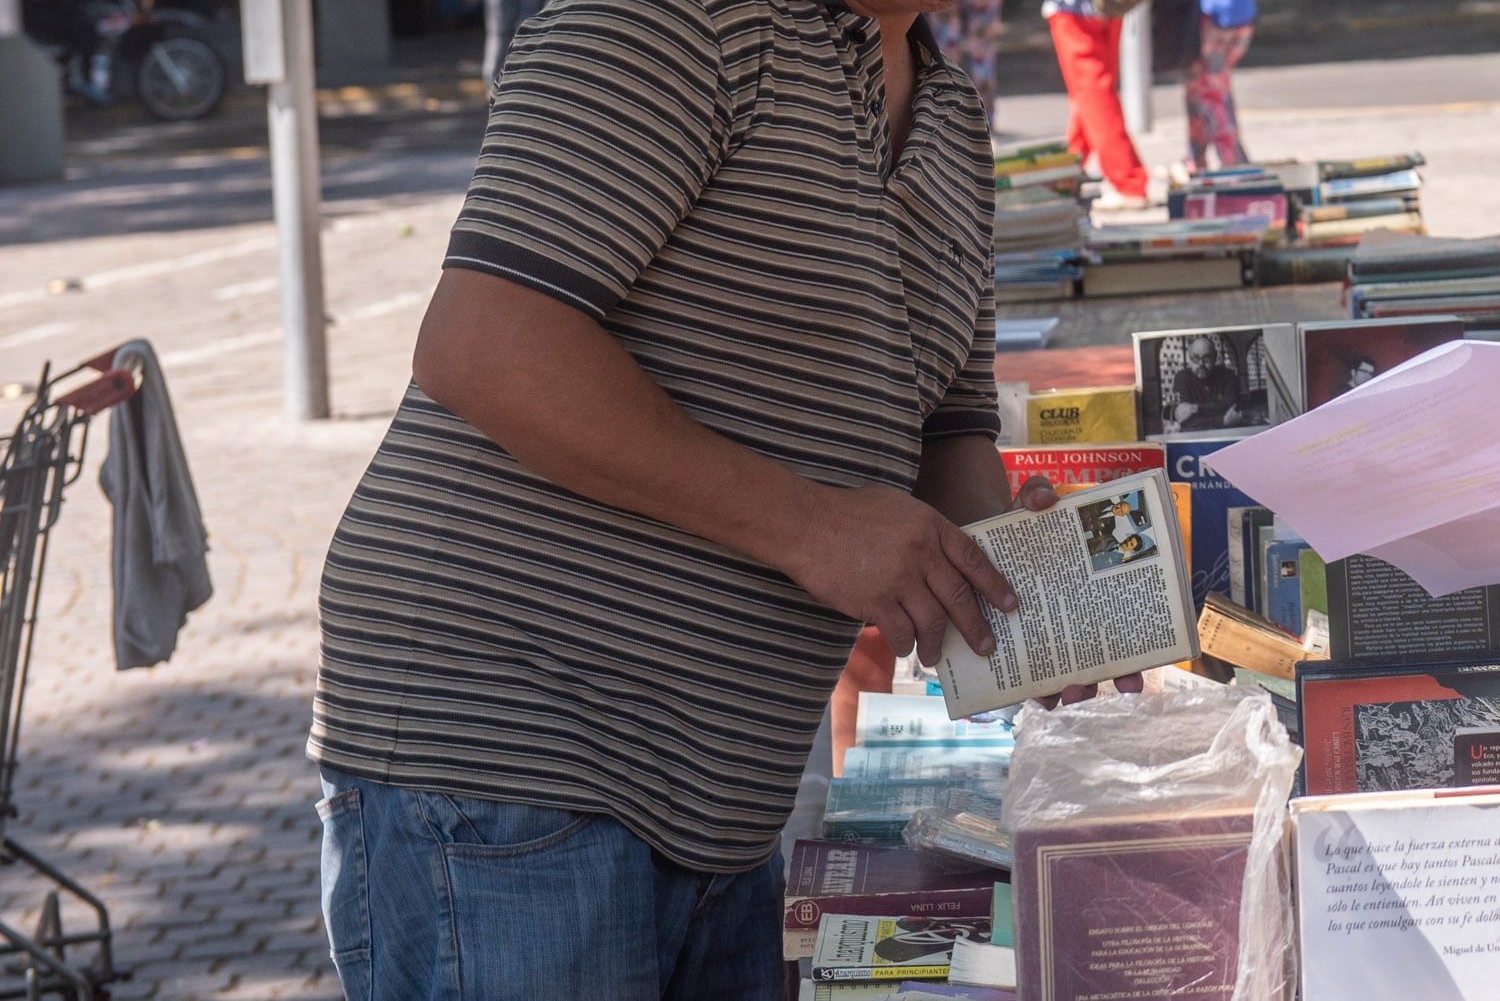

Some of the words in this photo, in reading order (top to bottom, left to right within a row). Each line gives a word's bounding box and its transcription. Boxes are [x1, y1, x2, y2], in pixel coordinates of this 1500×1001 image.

[1040, 407, 1080, 419] CLUB
[1015, 453, 1057, 465] PAUL
[1061, 451, 1142, 464] JOHNSON
[1176, 454, 1216, 478] CR
[1324, 843, 1341, 856] Lo
[1343, 845, 1363, 859] que
[1393, 839, 1404, 852] la
[1407, 838, 1444, 853] fuerza
[1448, 838, 1490, 848] externa
[1326, 861, 1361, 874] Pascal
[1363, 863, 1373, 872] es
[1376, 862, 1396, 876] que
[1400, 858, 1420, 874] hay
[1423, 858, 1458, 869] tantos
[1326, 882, 1367, 893] cuantos
[1371, 876, 1422, 894] leyéndole
[1424, 875, 1434, 888] le
[1438, 876, 1477, 886] sienten
[1481, 876, 1487, 888] y
[801, 903, 813, 921] EB
[910, 903, 934, 912] LUNA
[1327, 899, 1347, 912] sólo
[1350, 898, 1360, 911] le
[1363, 896, 1421, 910] entienden.
[1424, 894, 1444, 906] Así
[1447, 895, 1480, 905] viven
[1483, 894, 1496, 903] en
[1327, 919, 1341, 931] los
[1345, 921, 1365, 934] que
[1368, 915, 1421, 930] comulgan
[1425, 916, 1444, 925] con
[1447, 916, 1459, 924] su
[1461, 910, 1472, 926] fe
[1443, 944, 1473, 956] Miguel
[1474, 943, 1484, 952] de
[897, 968, 949, 976] PRINCIPIANTE
